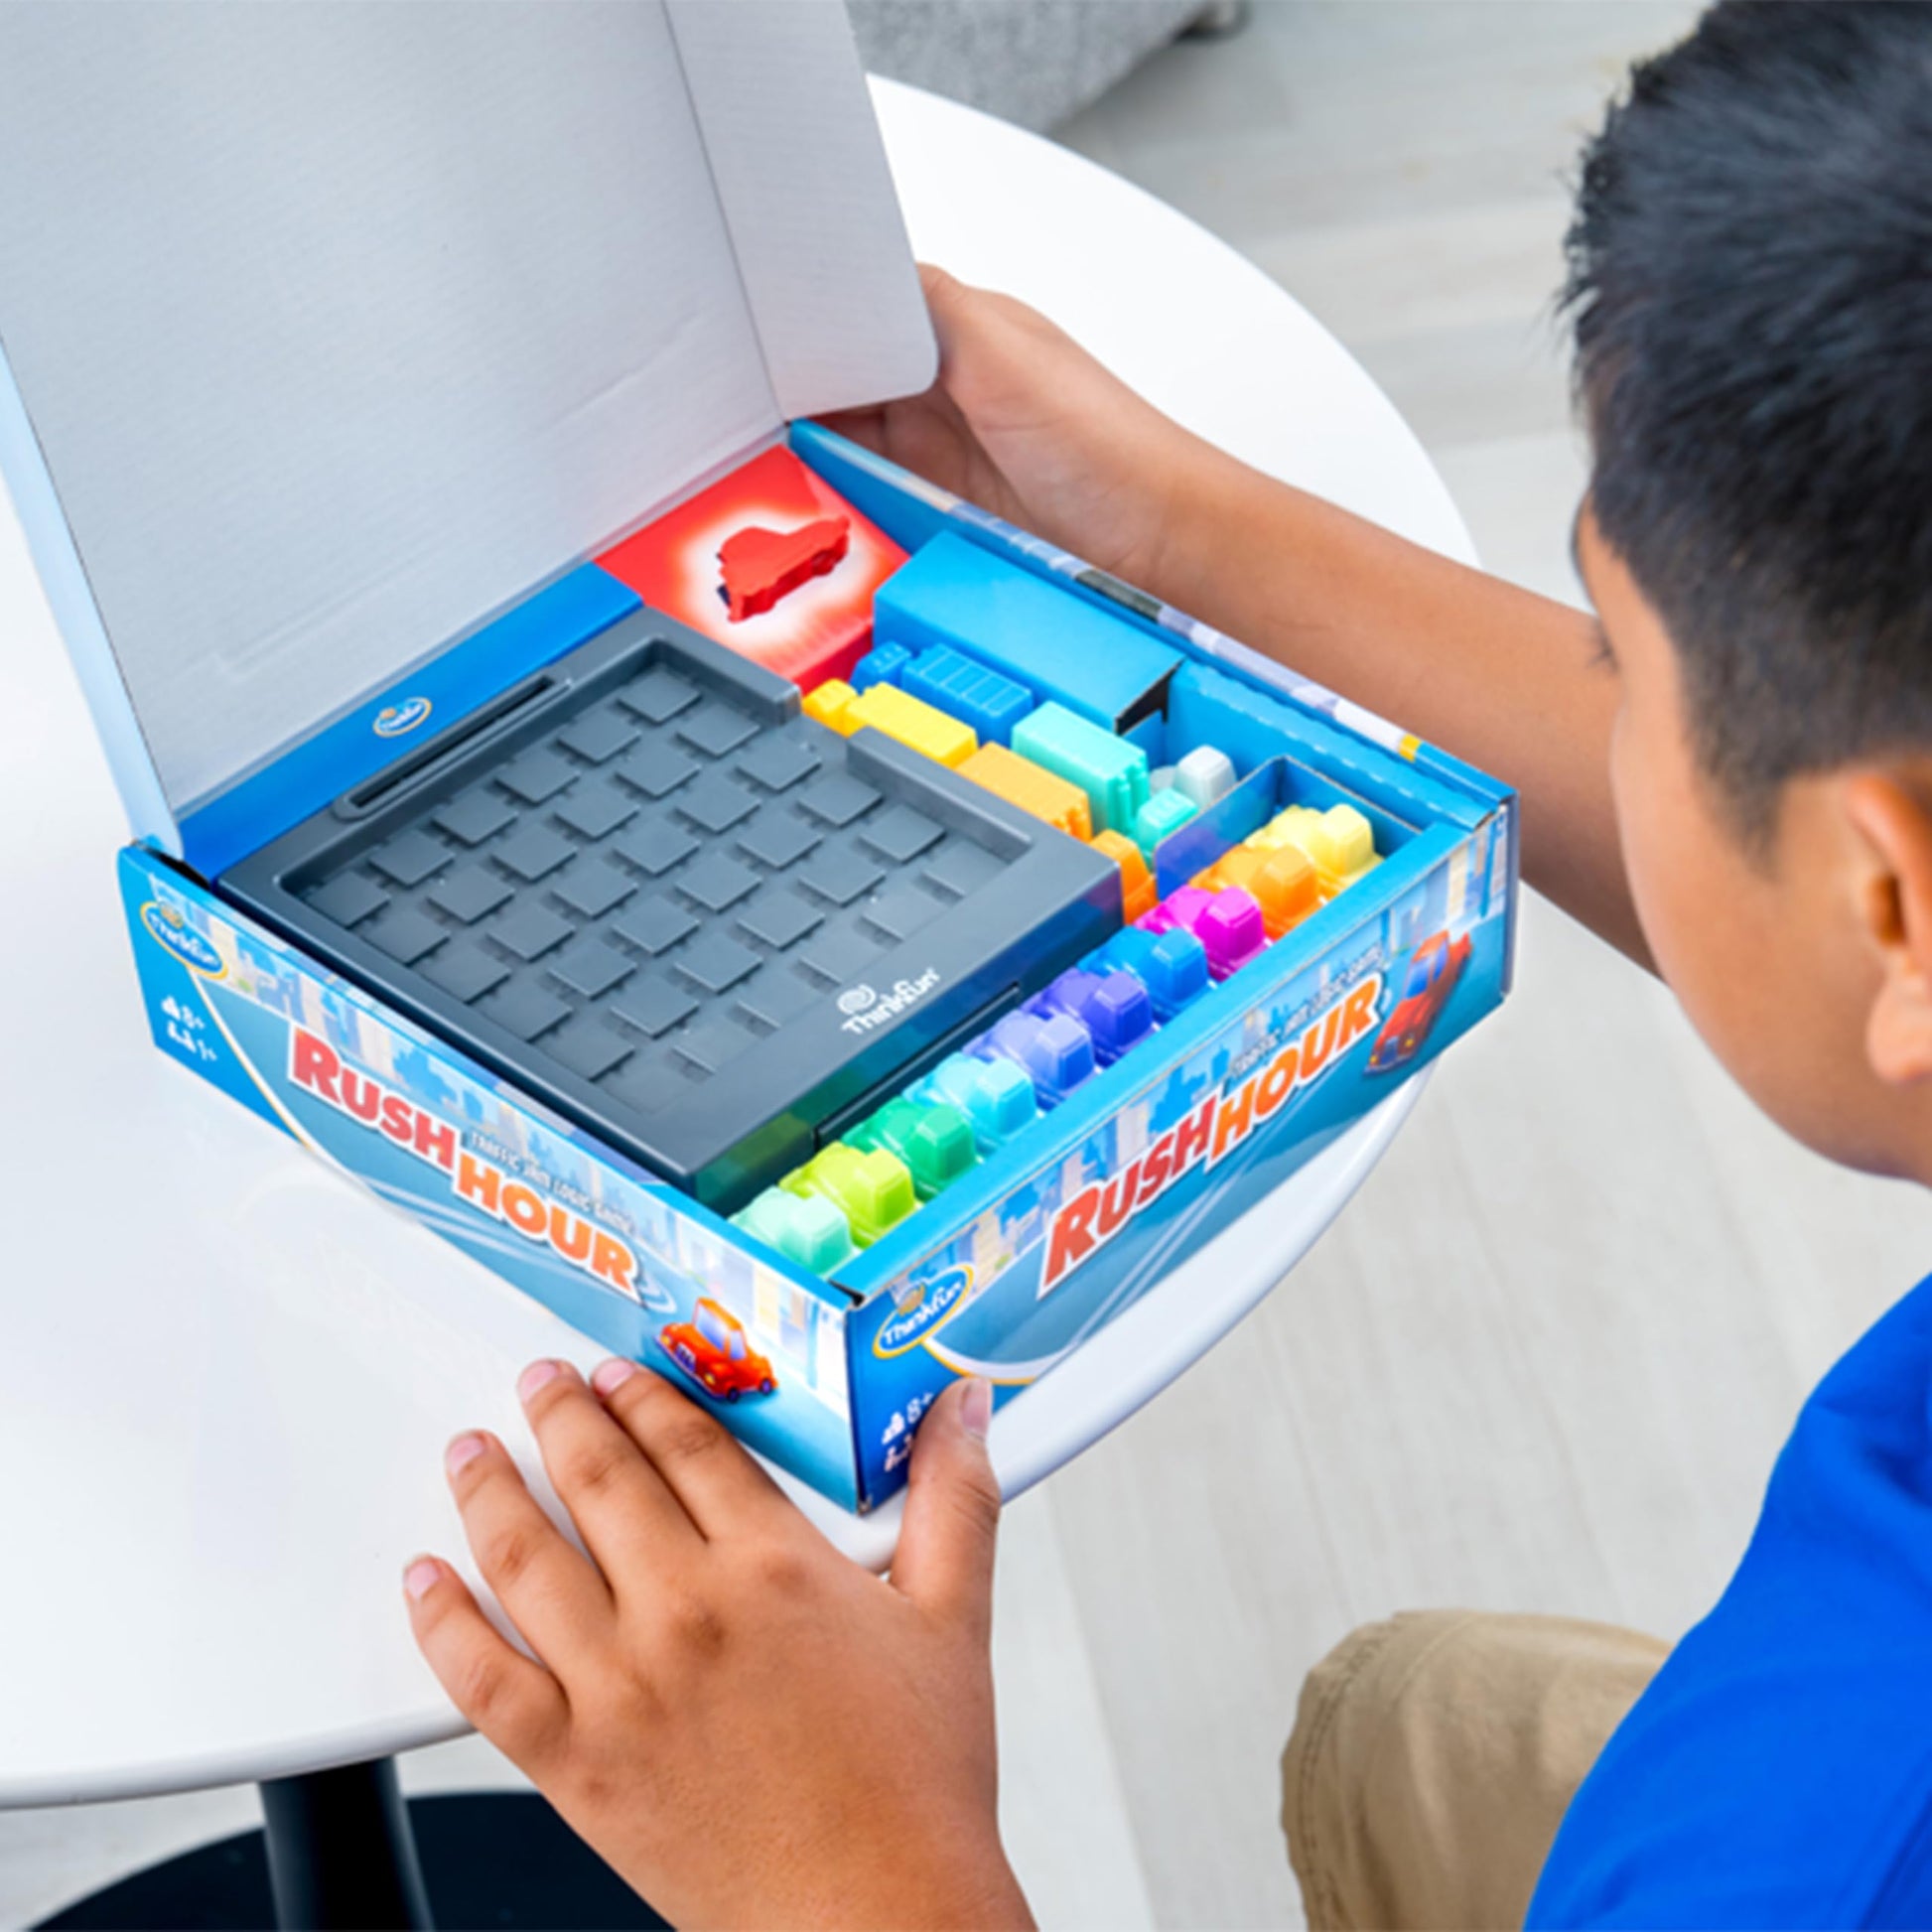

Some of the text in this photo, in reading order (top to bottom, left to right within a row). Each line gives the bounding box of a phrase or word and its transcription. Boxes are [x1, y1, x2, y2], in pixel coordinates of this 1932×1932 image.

[292, 1025, 636, 1297] RUSH HOUR
[1041, 977, 1379, 1289] RUSH HOUR
